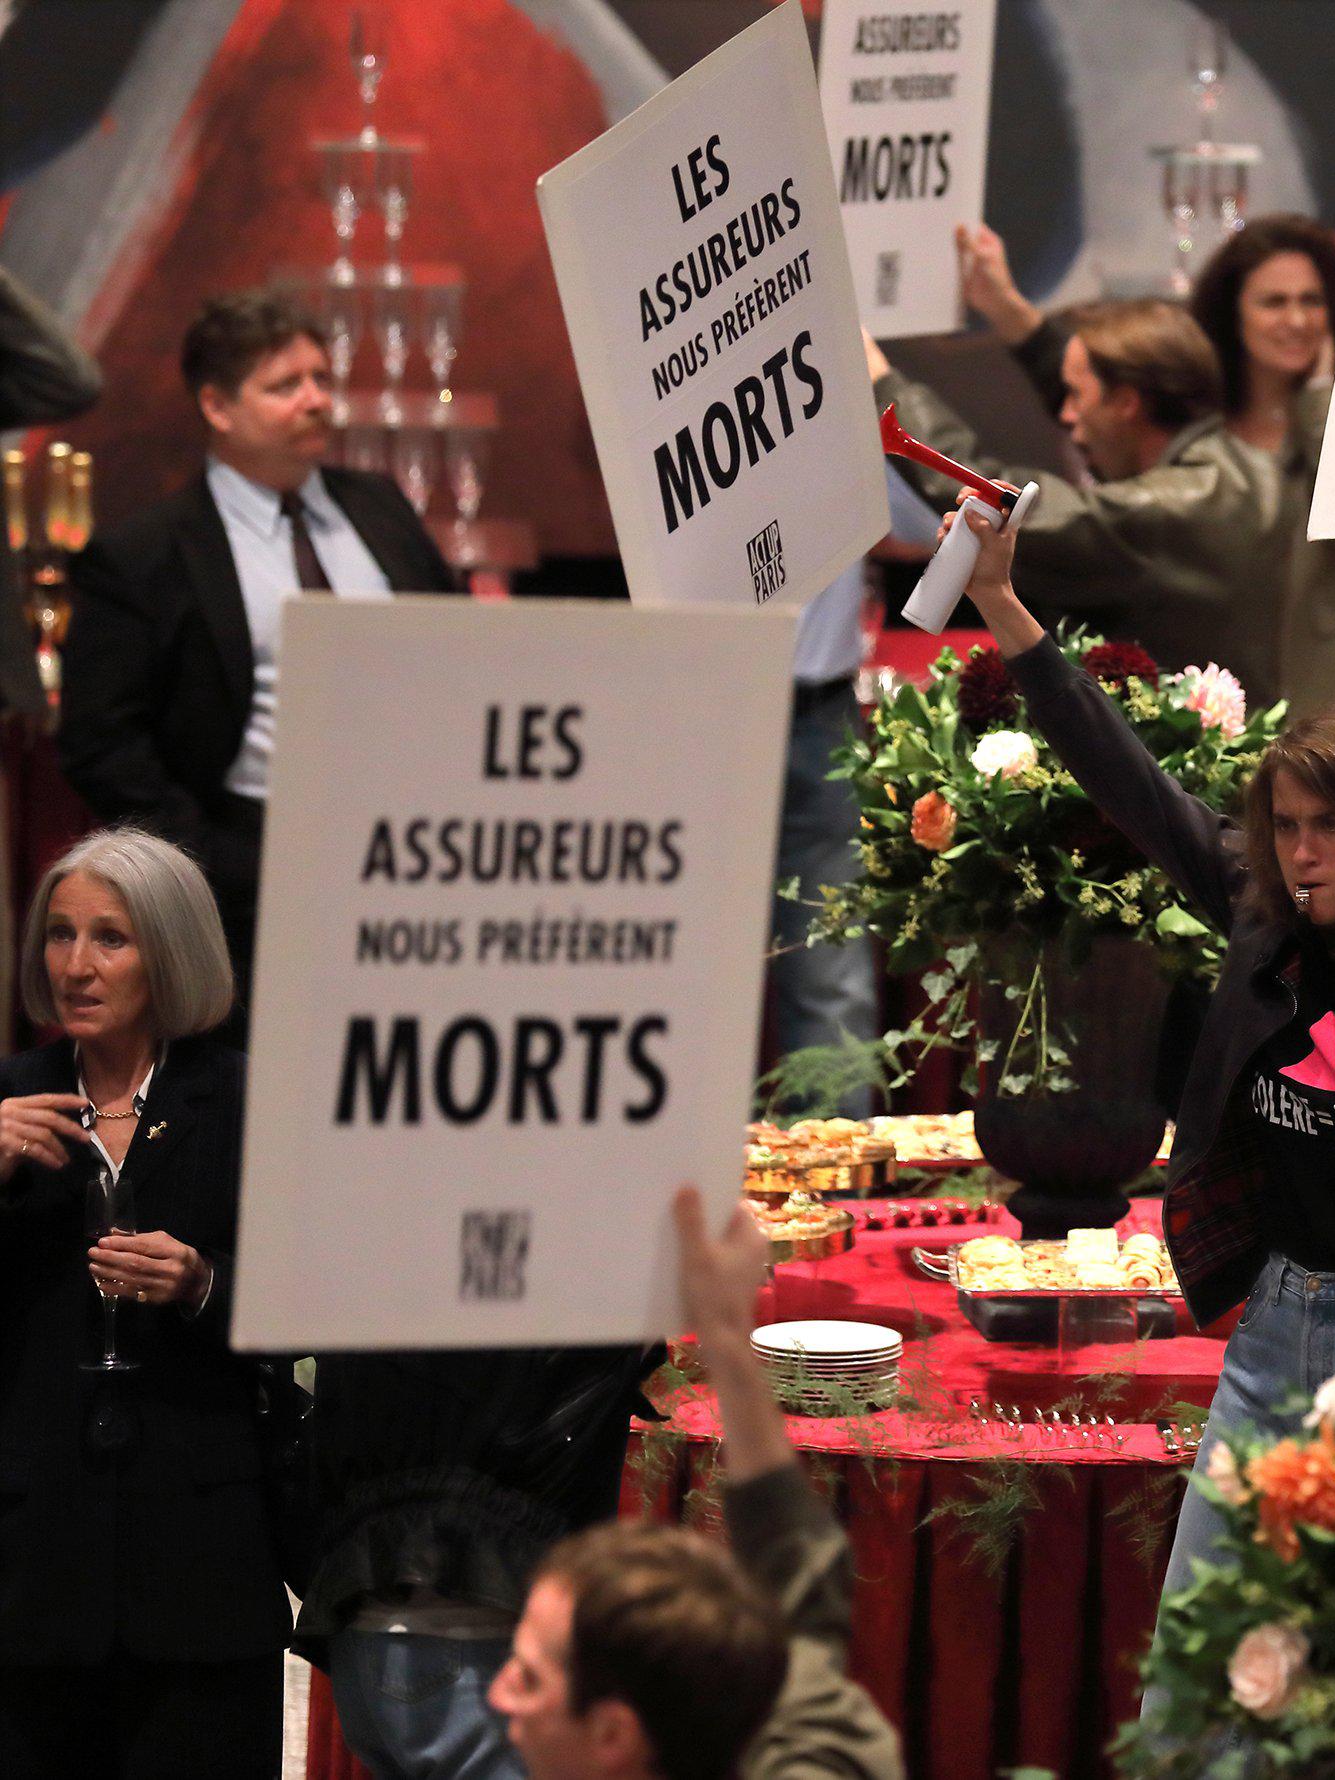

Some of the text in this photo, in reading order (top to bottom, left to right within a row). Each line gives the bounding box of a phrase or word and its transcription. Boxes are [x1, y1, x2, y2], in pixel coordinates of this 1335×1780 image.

[672, 134, 729, 223] LES
[840, 131, 951, 203] MORTS
[639, 177, 801, 342] ASSUREURS
[651, 332, 709, 401] NOUS
[710, 249, 812, 355] PRÉFÈRENT
[653, 330, 823, 534] MORTS
[753, 554, 786, 605] PARIS
[482, 705, 584, 780] LES
[361, 818, 685, 884] ASSUREURS
[355, 918, 463, 965] NOUS
[334, 1014, 669, 1126] MORTS
